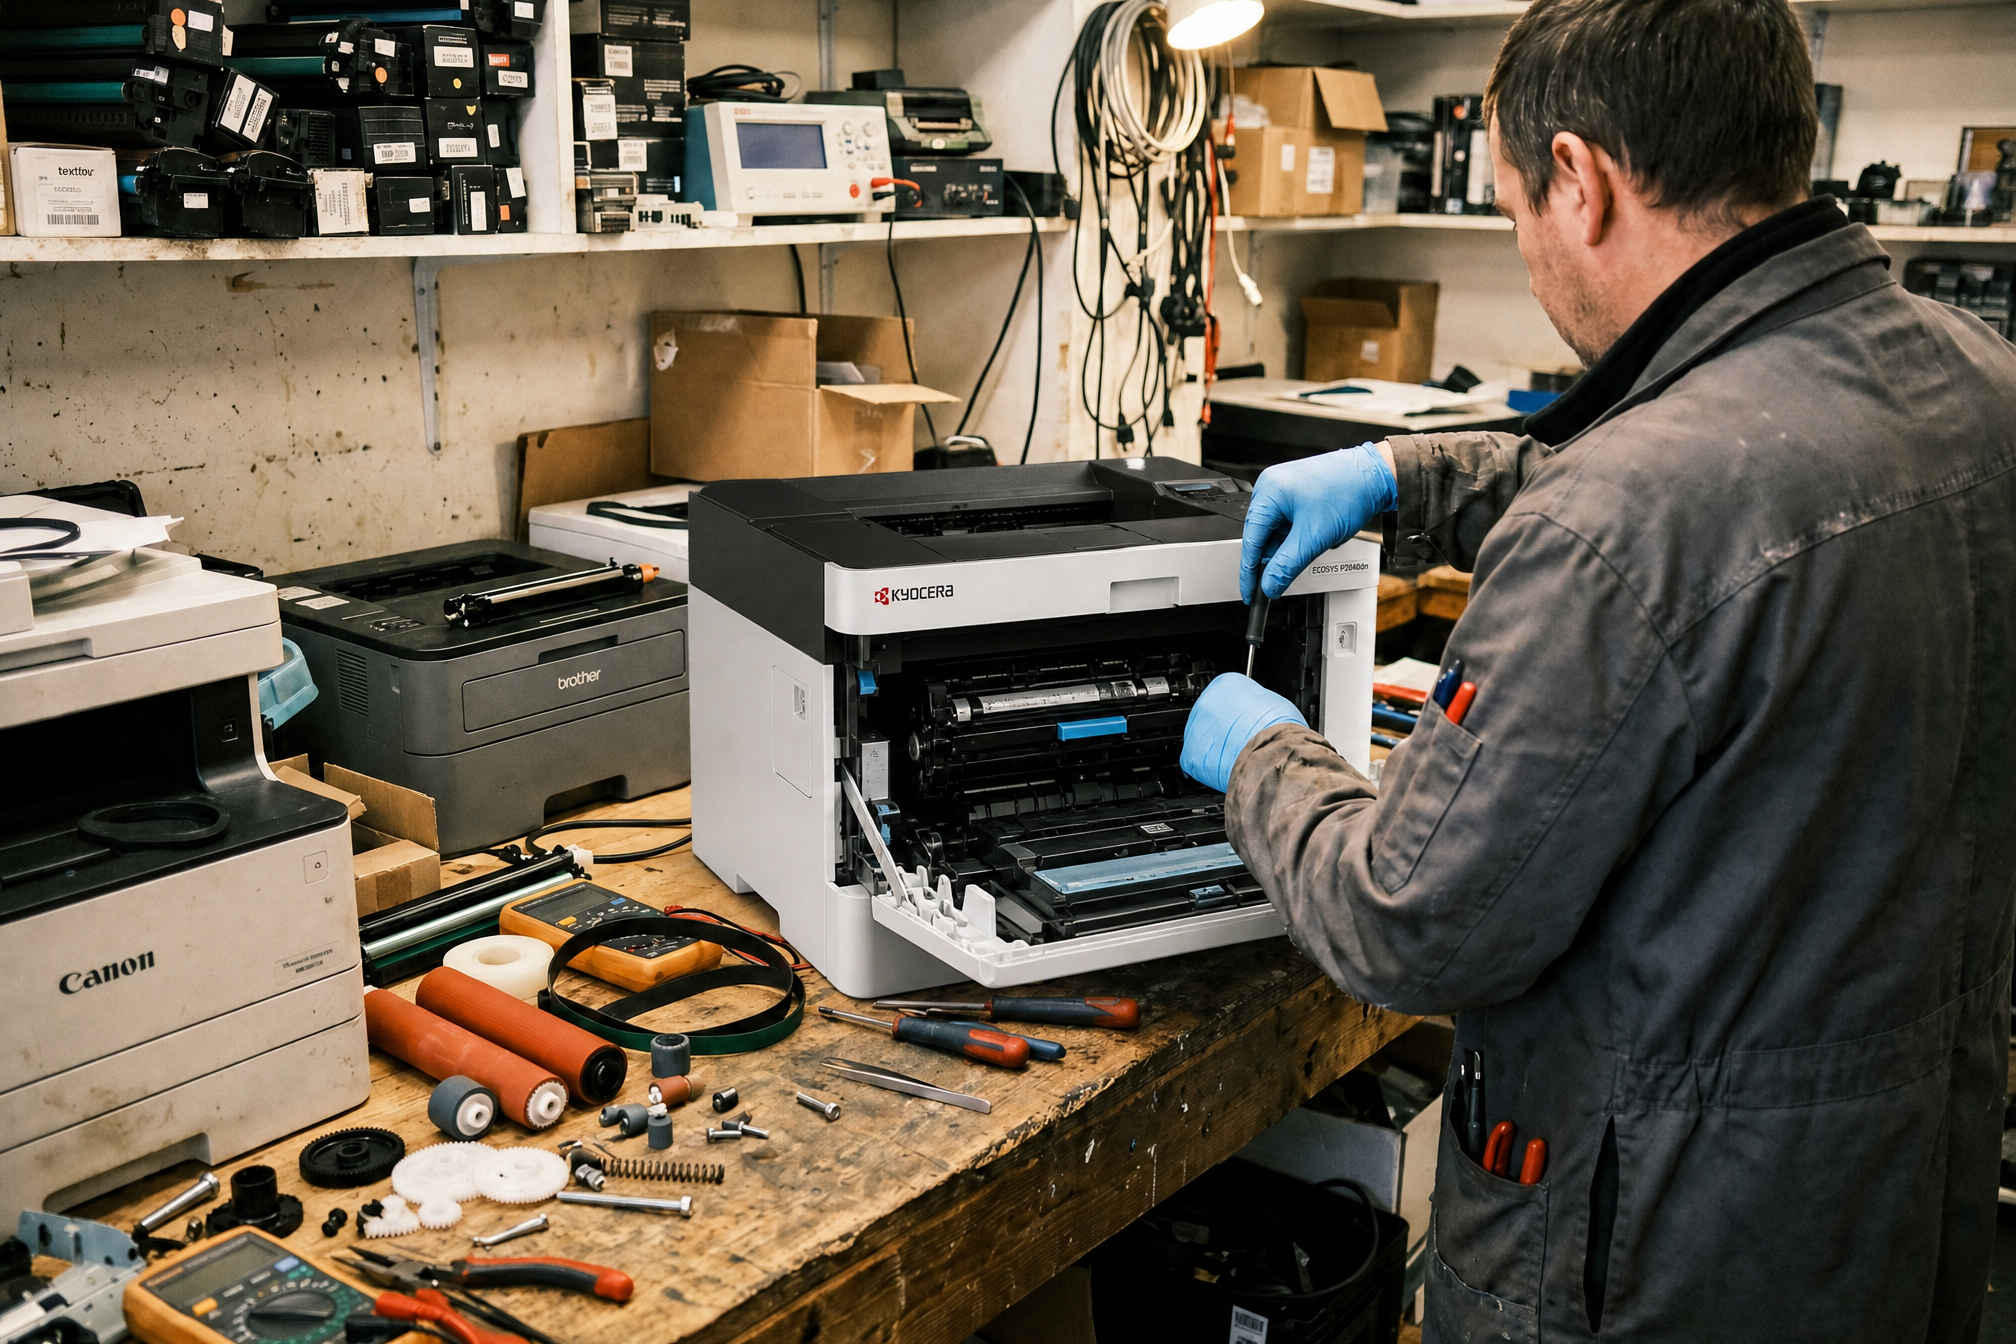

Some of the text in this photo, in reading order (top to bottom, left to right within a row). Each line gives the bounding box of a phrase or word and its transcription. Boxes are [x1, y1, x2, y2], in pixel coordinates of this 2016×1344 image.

[1312, 565, 1339, 575] ECOSYS
[891, 584, 954, 602] KYOCERA
[557, 669, 602, 690] brother
[58, 950, 155, 995] Canon
